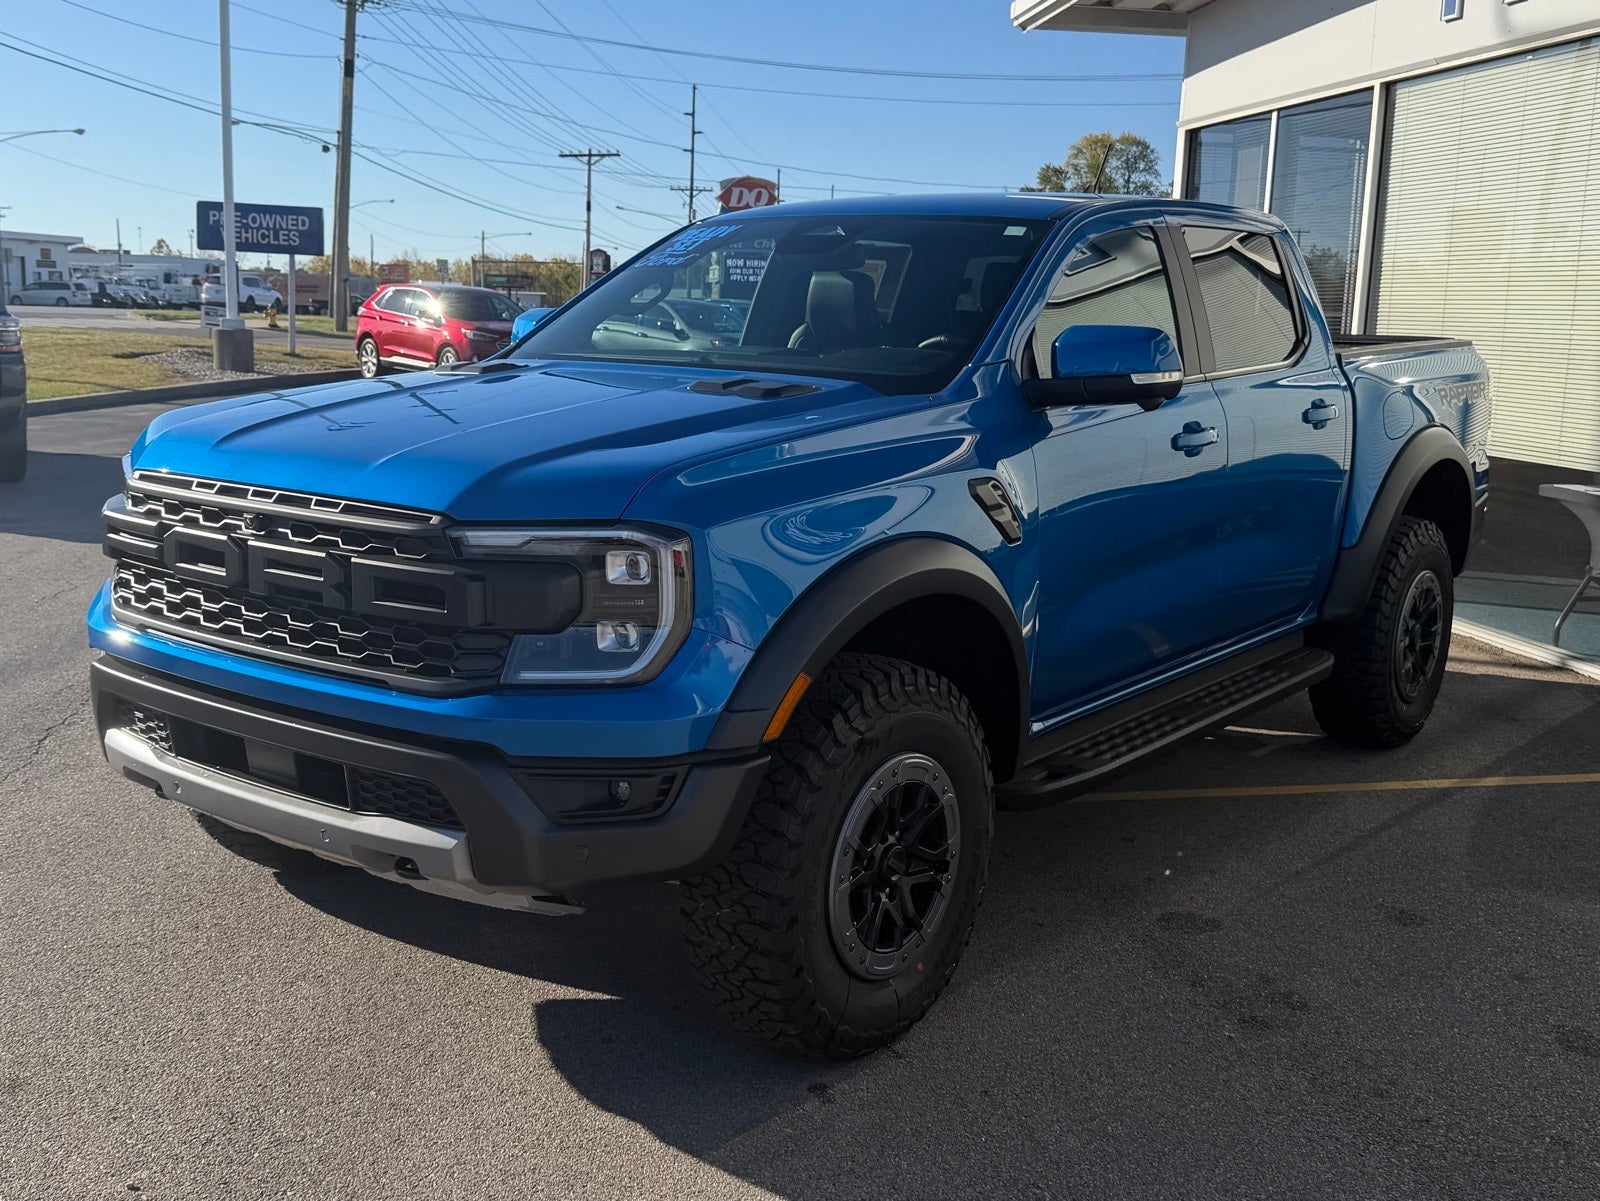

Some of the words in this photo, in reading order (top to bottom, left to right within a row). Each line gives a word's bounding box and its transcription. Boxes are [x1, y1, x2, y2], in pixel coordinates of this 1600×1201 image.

[728, 187, 769, 207] DQ
[209, 210, 309, 230] PE-OWNED
[726, 258, 744, 268] NOW
[746, 259, 767, 268] HIRIN
[1437, 382, 1487, 409] RAPTOR
[104, 510, 484, 627] FORD
